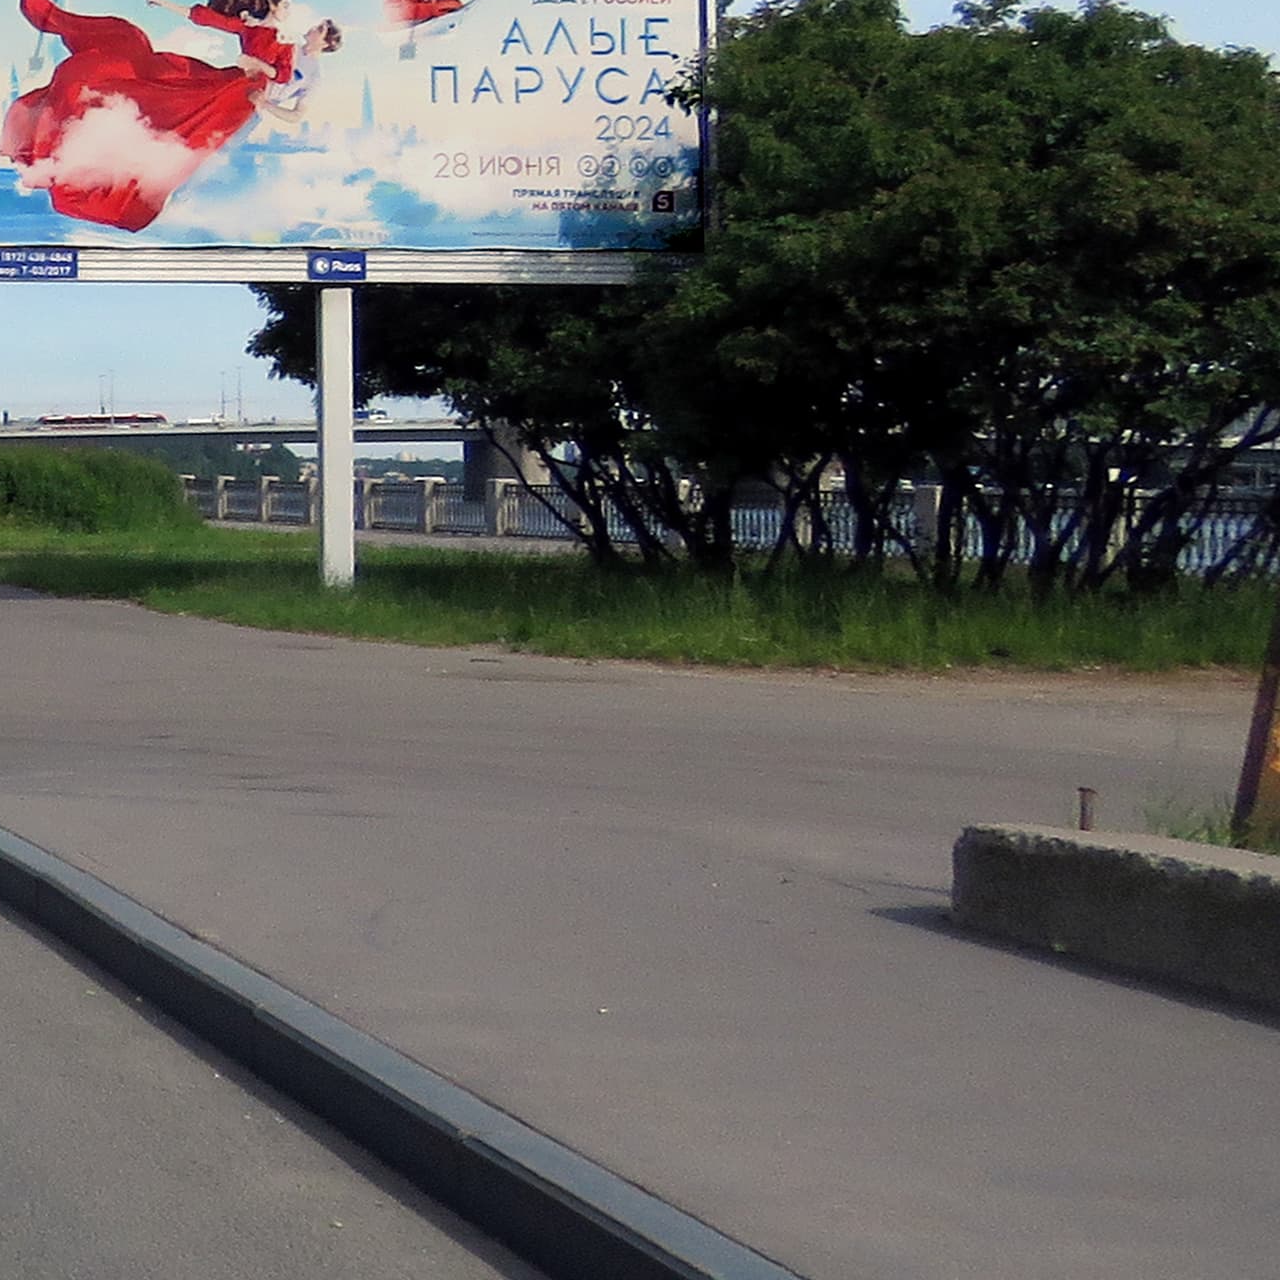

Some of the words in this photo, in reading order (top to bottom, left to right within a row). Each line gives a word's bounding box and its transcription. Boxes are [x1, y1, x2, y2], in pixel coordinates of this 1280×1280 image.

[500, 17, 672, 56] АЛЫЕ
[429, 65, 669, 105] ПАРУСА
[594, 114, 673, 142] 2024
[432, 152, 472, 179] 28
[479, 155, 562, 178] ИЮНЯ
[512, 188, 561, 199] ПРЯМАЯ
